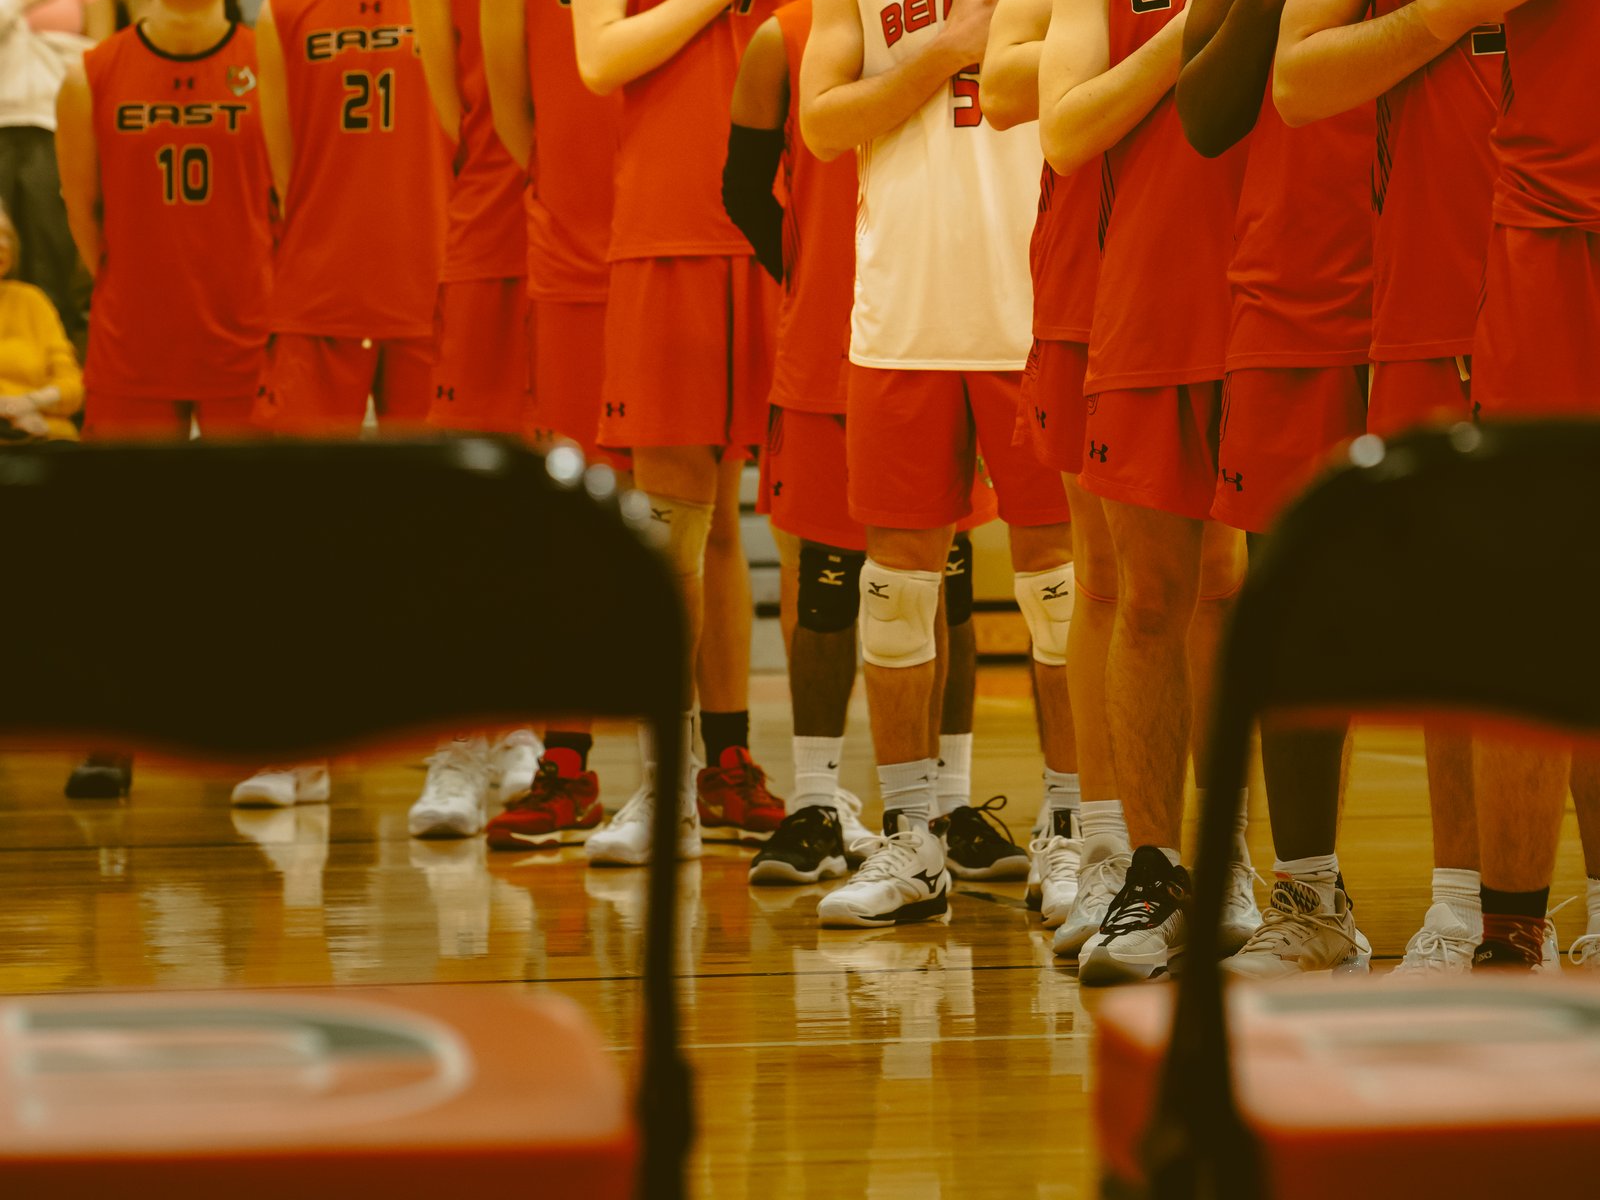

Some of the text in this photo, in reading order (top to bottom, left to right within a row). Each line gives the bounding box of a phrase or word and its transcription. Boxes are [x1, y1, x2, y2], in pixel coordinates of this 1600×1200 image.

[116, 103, 248, 132] EAST
[342, 69, 394, 132] 21
[156, 146, 211, 204] 10
